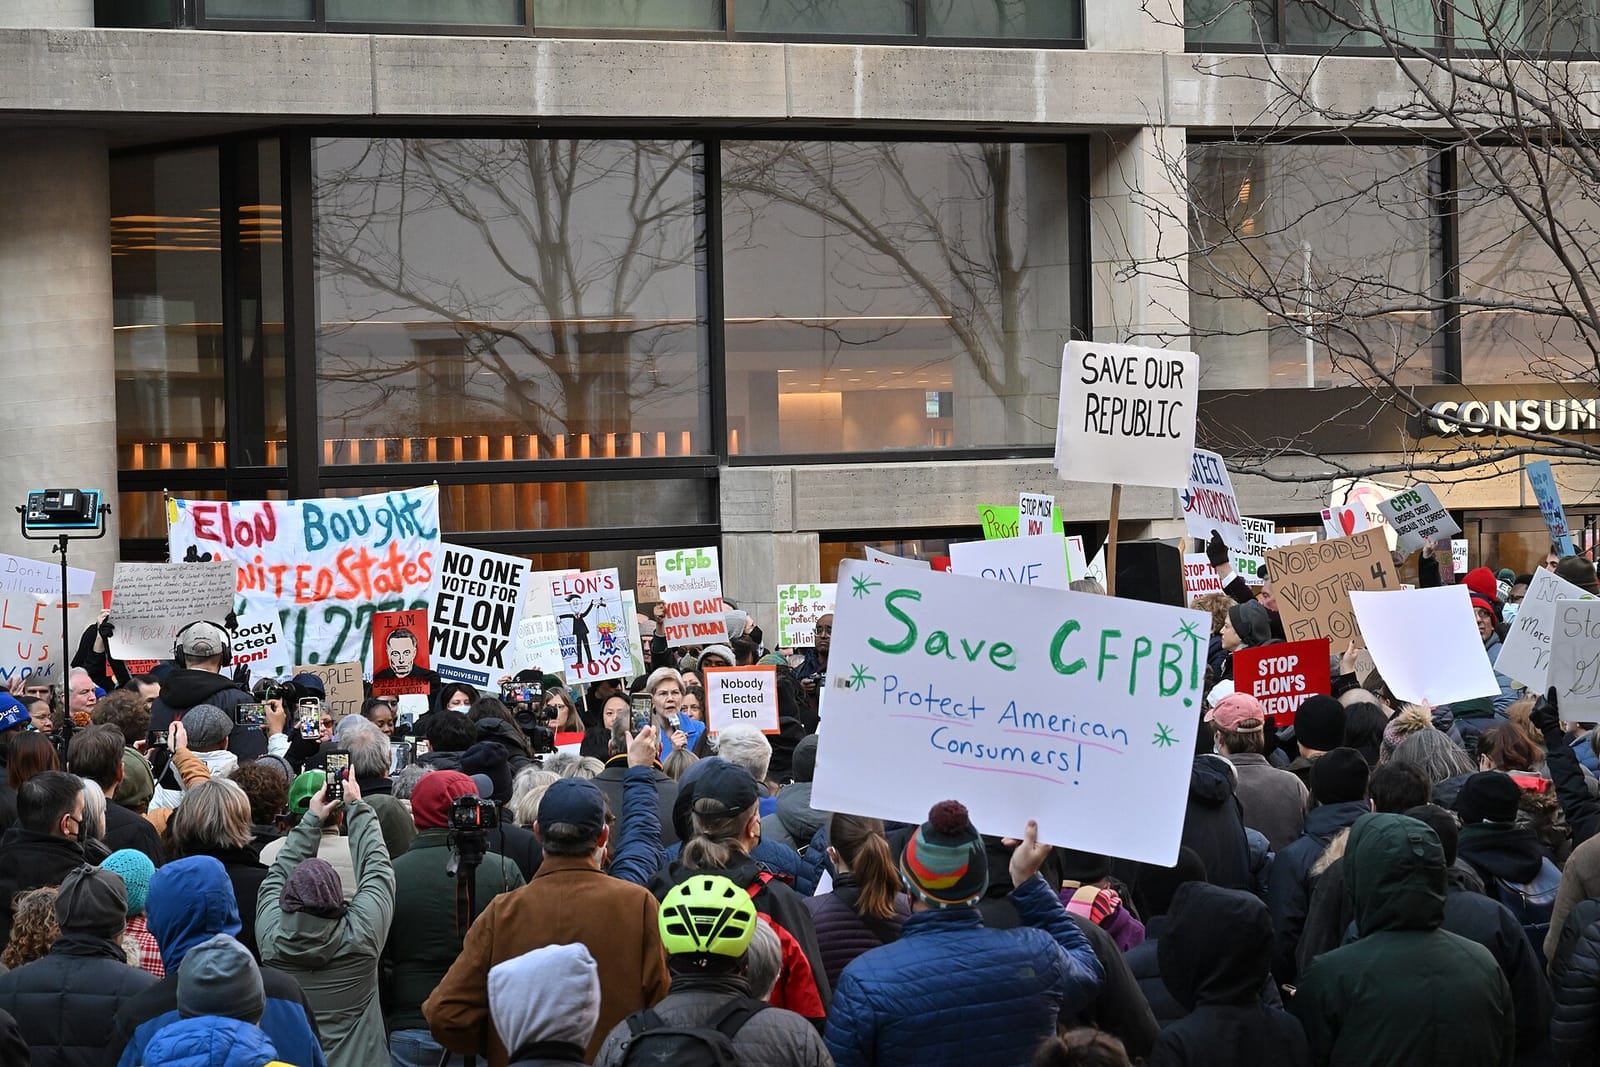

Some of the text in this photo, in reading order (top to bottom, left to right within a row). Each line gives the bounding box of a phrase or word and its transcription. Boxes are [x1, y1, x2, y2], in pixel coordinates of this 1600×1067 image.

[1080, 352, 1184, 389] SAVE OUR
[1084, 393, 1183, 438] REPUBLIC
[1020, 498, 1052, 518] STOP MUSK
[1390, 490, 1422, 512] CFPB
[302, 492, 438, 552] Bought
[1394, 503, 1432, 524] ORDERS CREDIT
[1418, 518, 1426, 526] TO
[1424, 508, 1448, 524] CORRECT
[442, 550, 524, 588] NO ONE
[665, 549, 712, 576] cfpb
[1265, 533, 1372, 584] NOBODY
[1184, 564, 1204, 576] STOP
[441, 575, 518, 604] VOTED FOR
[552, 575, 615, 597] ELON'S
[779, 584, 822, 604] cfpb
[1280, 561, 1388, 612] VOTED 4
[432, 592, 516, 637] ELON
[665, 600, 690, 619] YOU
[812, 601, 826, 612] for
[140, 624, 164, 640] TOOK
[384, 614, 416, 628] I AM
[666, 623, 689, 641] PUT
[1520, 616, 1551, 644] More
[18, 642, 49, 662] US
[428, 625, 510, 670] MUSK
[868, 588, 1200, 708] Save CFPB!
[445, 669, 488, 682] INDIVISIBLE
[570, 655, 622, 679] TOYS
[1258, 655, 1299, 677] STOP
[720, 678, 764, 691] Nobody
[1253, 674, 1306, 698] ELON'S
[722, 693, 764, 704] Elected
[732, 708, 757, 719] Elon
[882, 674, 1129, 746] Protect American
[930, 726, 1082, 785] Consumers!
